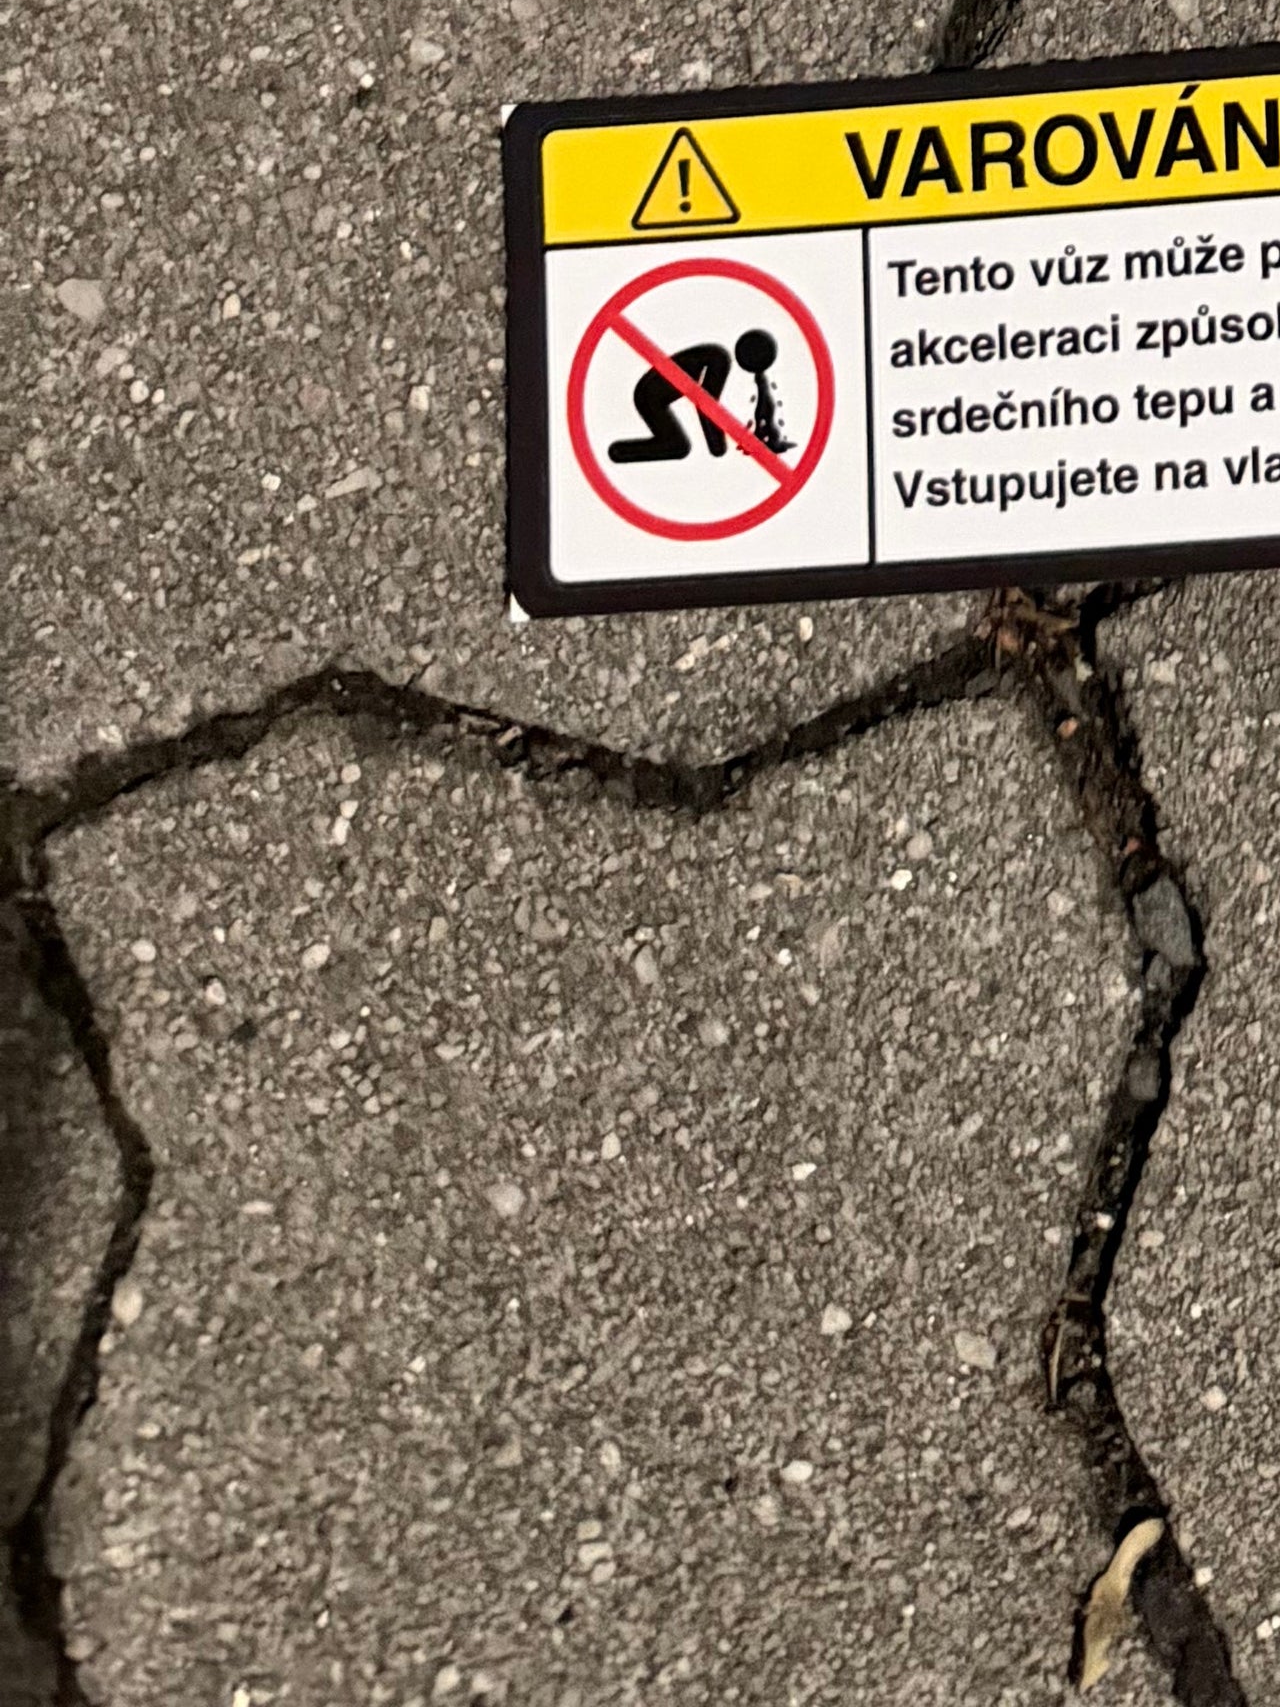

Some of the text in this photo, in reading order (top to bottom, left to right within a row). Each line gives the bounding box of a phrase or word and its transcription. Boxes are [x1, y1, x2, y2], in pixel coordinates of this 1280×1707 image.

[886, 255, 1016, 298] Tento
[1029, 244, 1111, 288] vůz
[1123, 233, 1246, 281] může
[889, 313, 1121, 369] akceleraci
[891, 386, 1121, 439] srdečního
[1132, 384, 1235, 429] tepu
[1249, 382, 1275, 414] a
[892, 458, 1140, 513] Vstupujete
[1154, 458, 1209, 492] na
